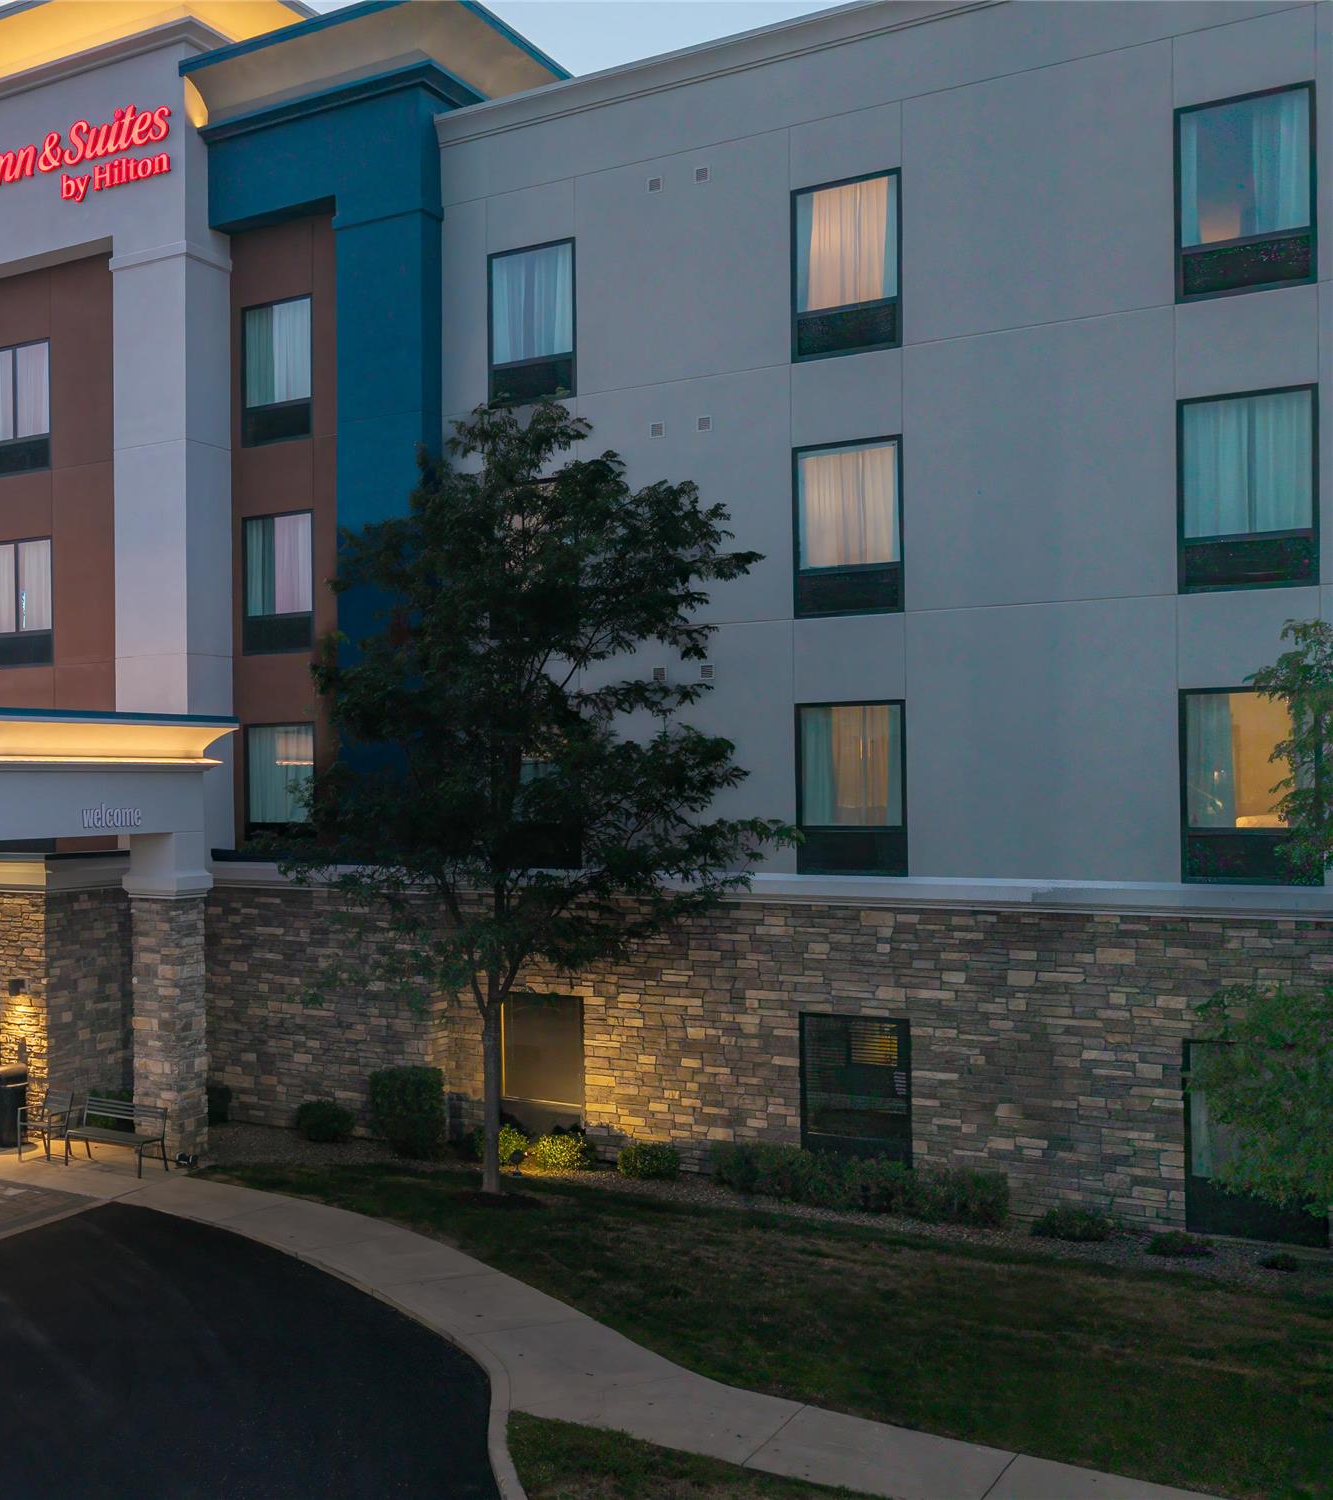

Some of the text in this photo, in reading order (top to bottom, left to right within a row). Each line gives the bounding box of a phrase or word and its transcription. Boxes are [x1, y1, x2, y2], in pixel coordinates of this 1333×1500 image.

[61, 152, 171, 203] by Hilton
[82, 802, 142, 829] welcome
